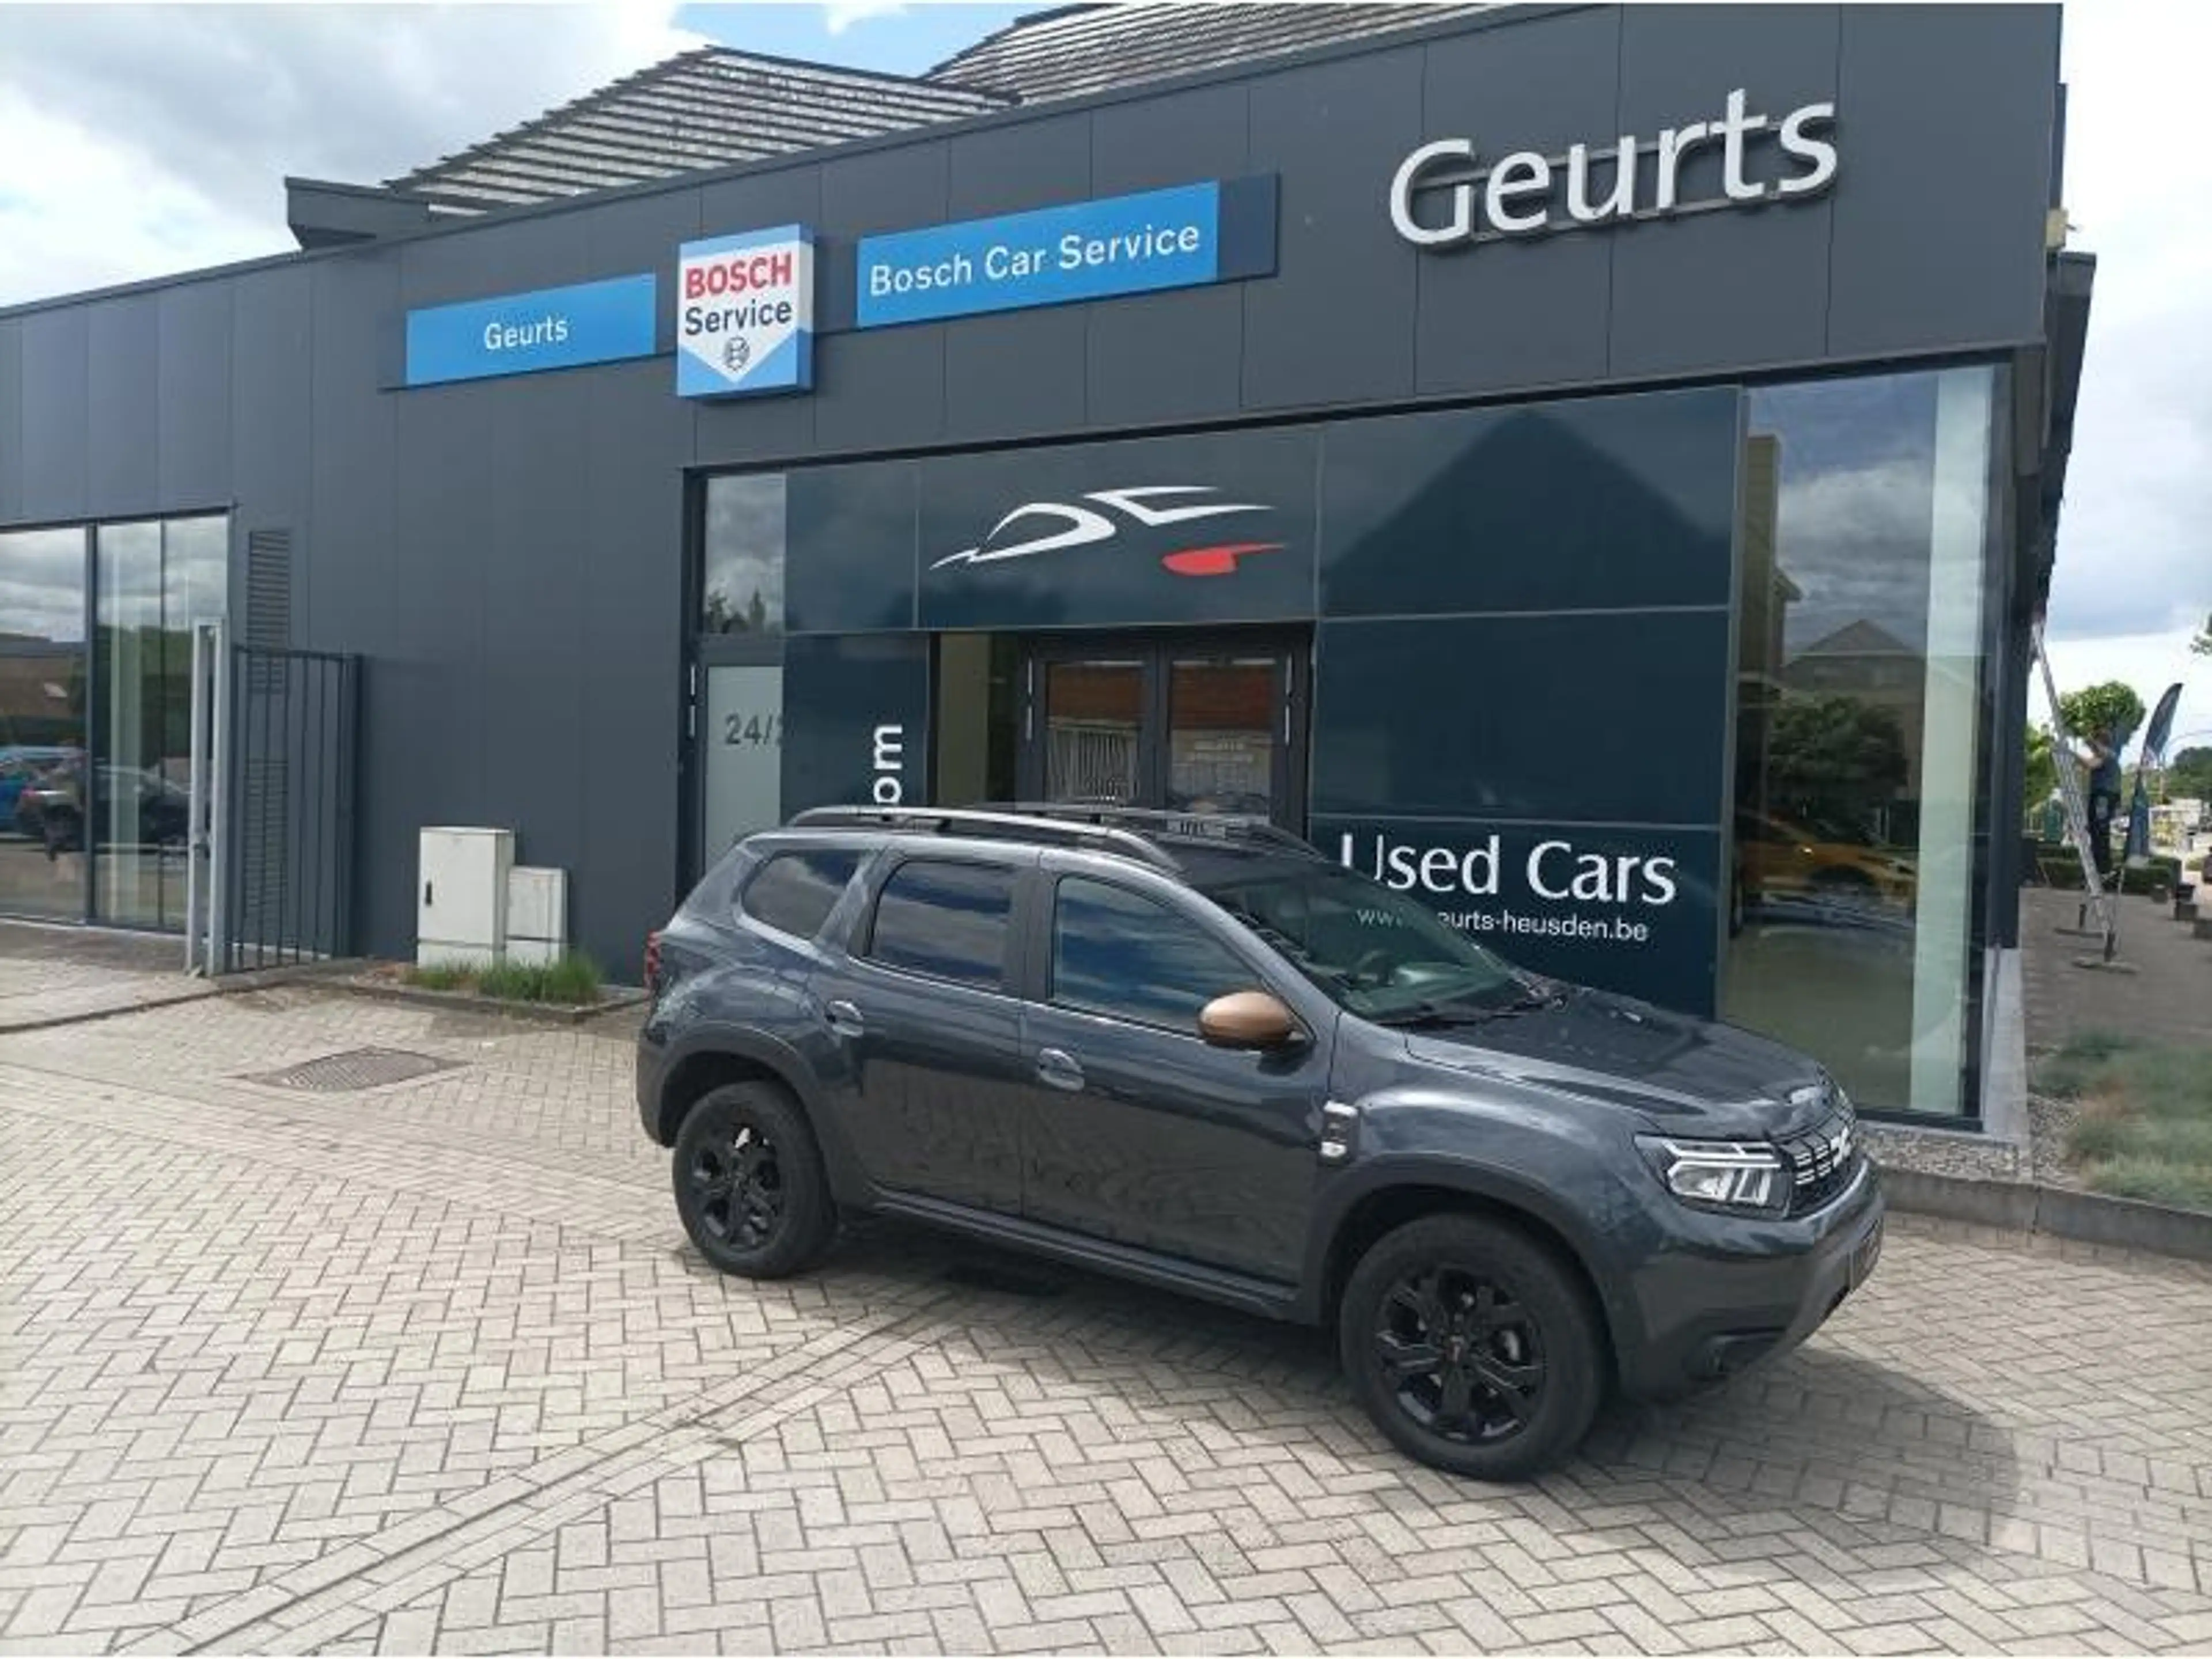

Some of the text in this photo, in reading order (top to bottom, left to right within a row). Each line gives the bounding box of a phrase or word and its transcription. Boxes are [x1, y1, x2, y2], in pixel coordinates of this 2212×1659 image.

[1390, 88, 1838, 245] Geurts
[685, 251, 792, 300] BOSCH
[870, 224, 1199, 296] Bosch Car Service
[484, 315, 567, 350] Geurts
[685, 298, 792, 335] Service
[725, 713, 782, 745] 24/
[1341, 833, 1677, 904] Used Cars
